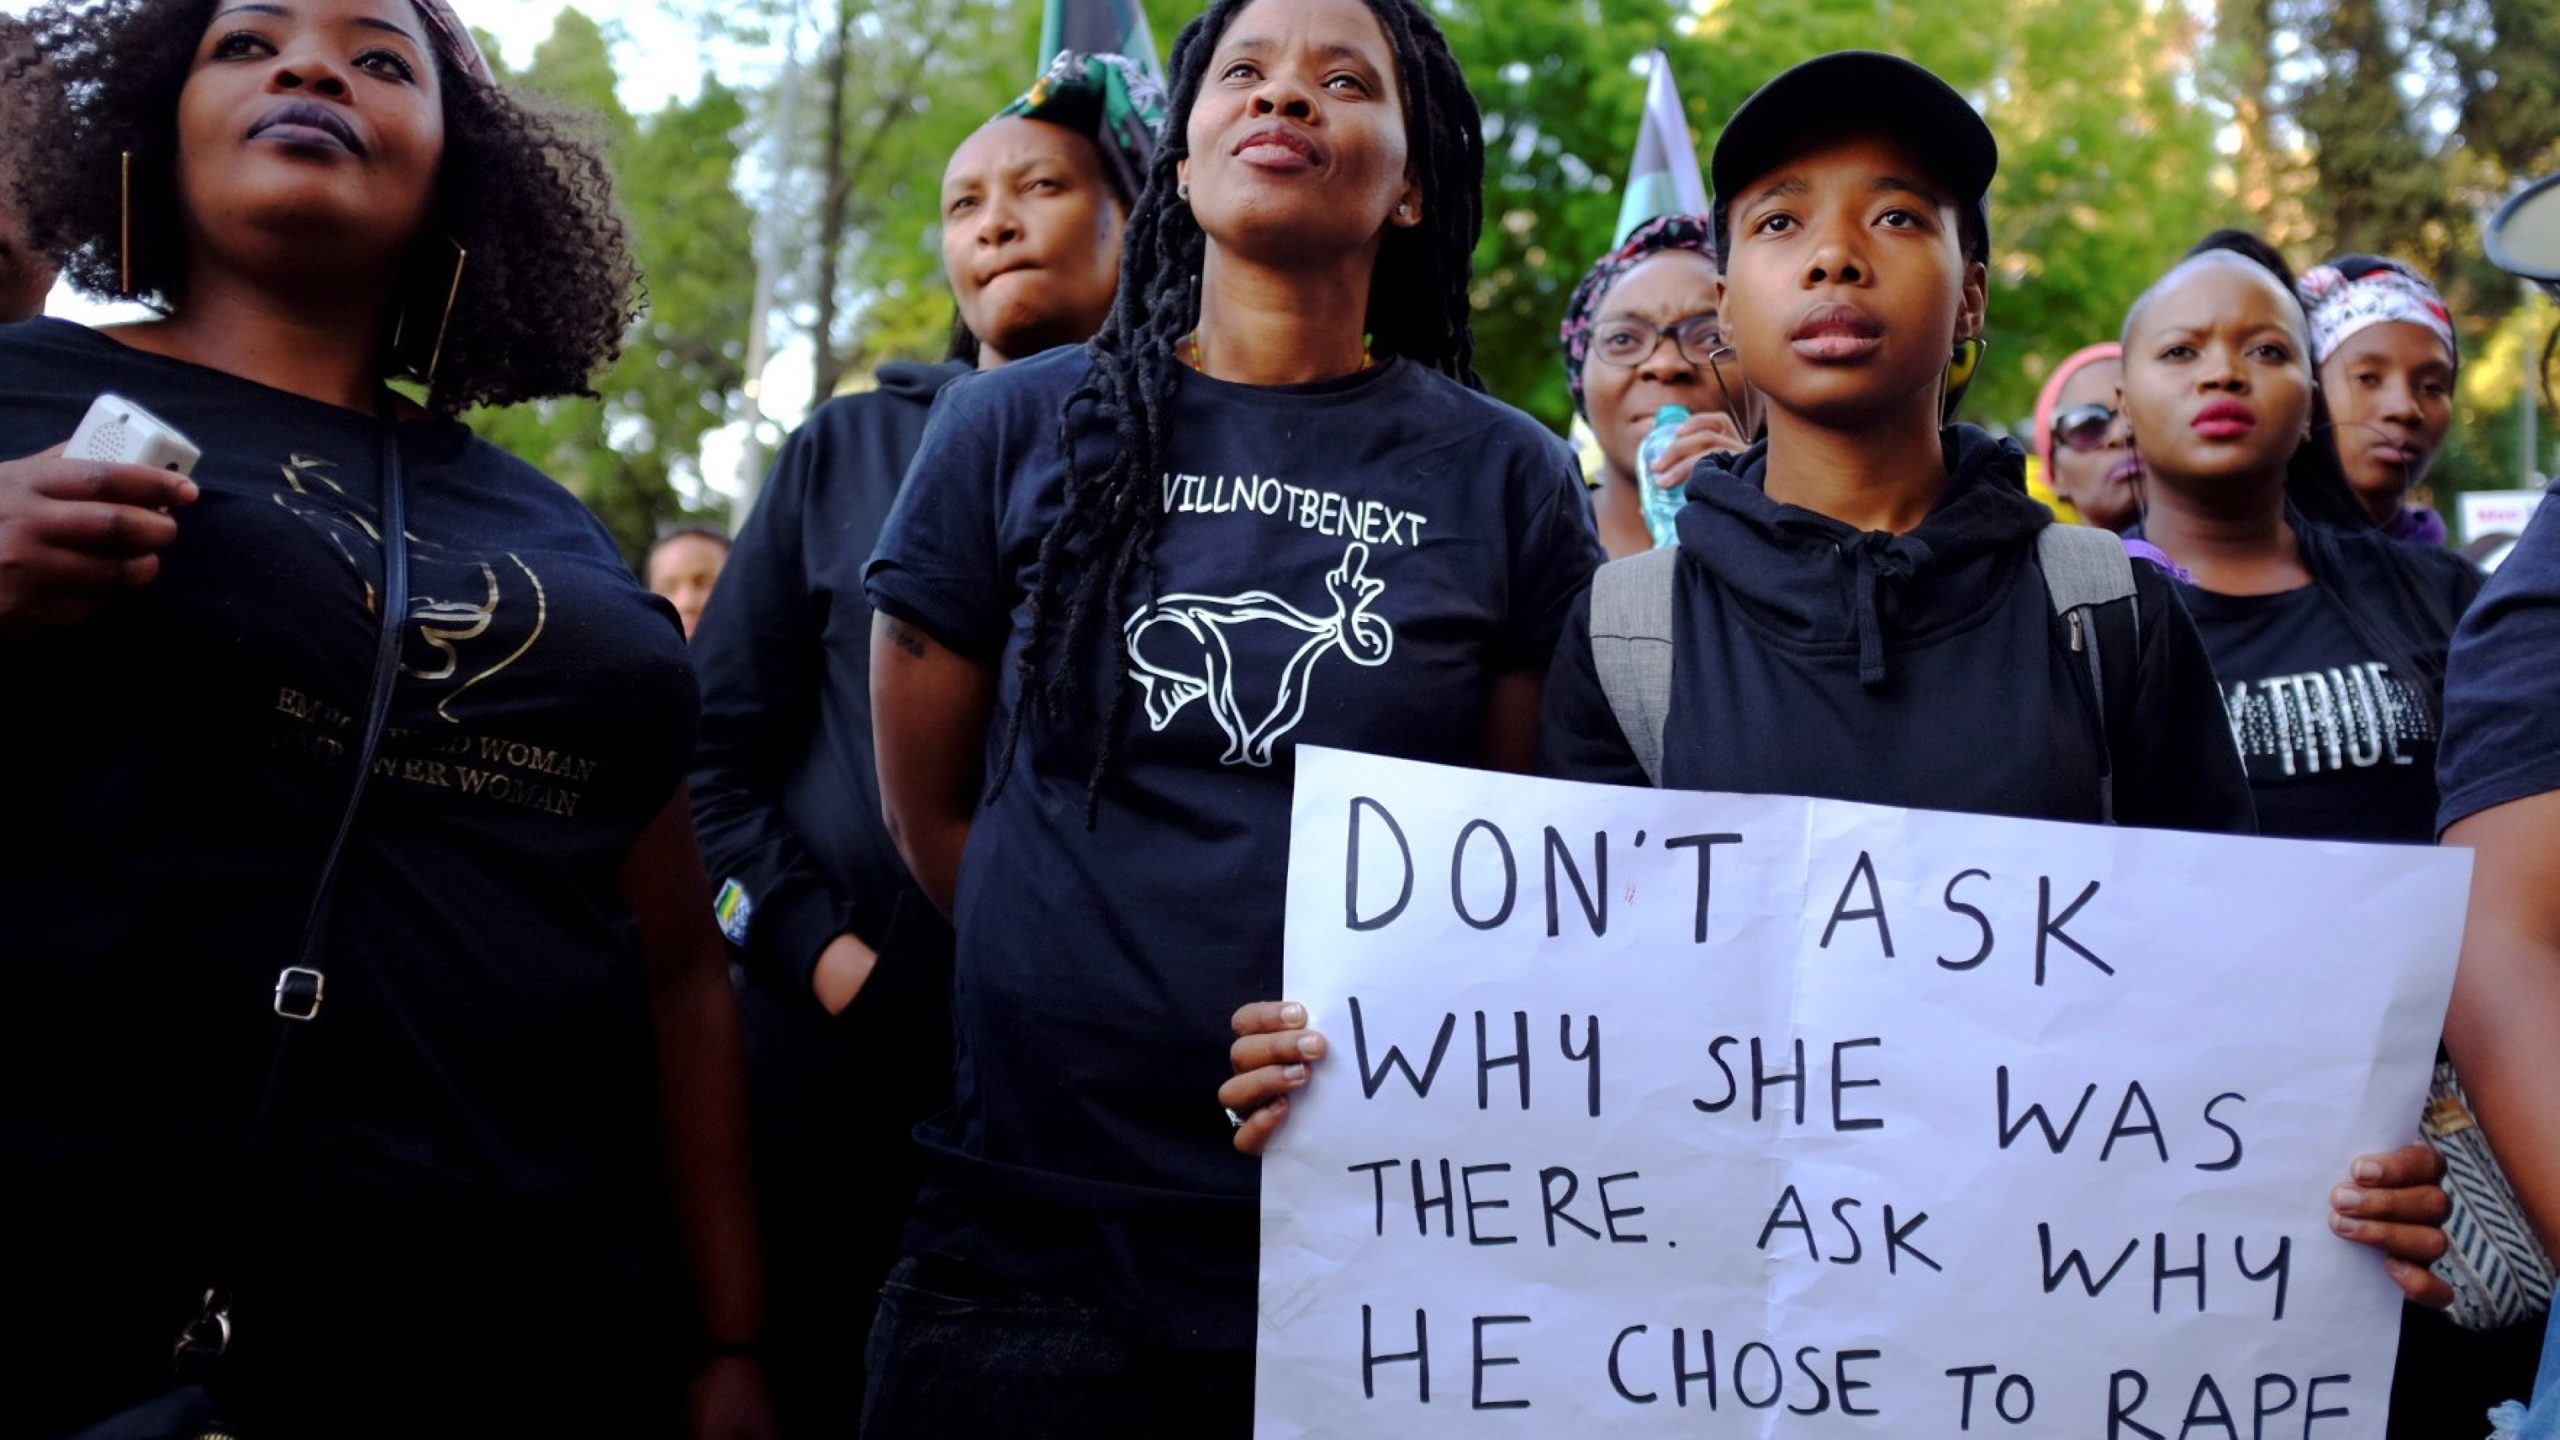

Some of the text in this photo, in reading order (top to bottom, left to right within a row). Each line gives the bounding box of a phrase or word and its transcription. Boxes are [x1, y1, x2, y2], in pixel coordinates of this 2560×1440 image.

[454, 765, 582, 818] WOMAN
[479, 734, 598, 783] WOMAN
[1345, 794, 2116, 986] DON'T ASK
[1348, 996, 2246, 1172] WHY SHE WAS
[1347, 1157, 2291, 1321] THERE. ASK WHY
[1361, 1304, 1532, 1411] HE
[1607, 1324, 1881, 1417] CHOSE
[1944, 1363, 2036, 1431] TO
